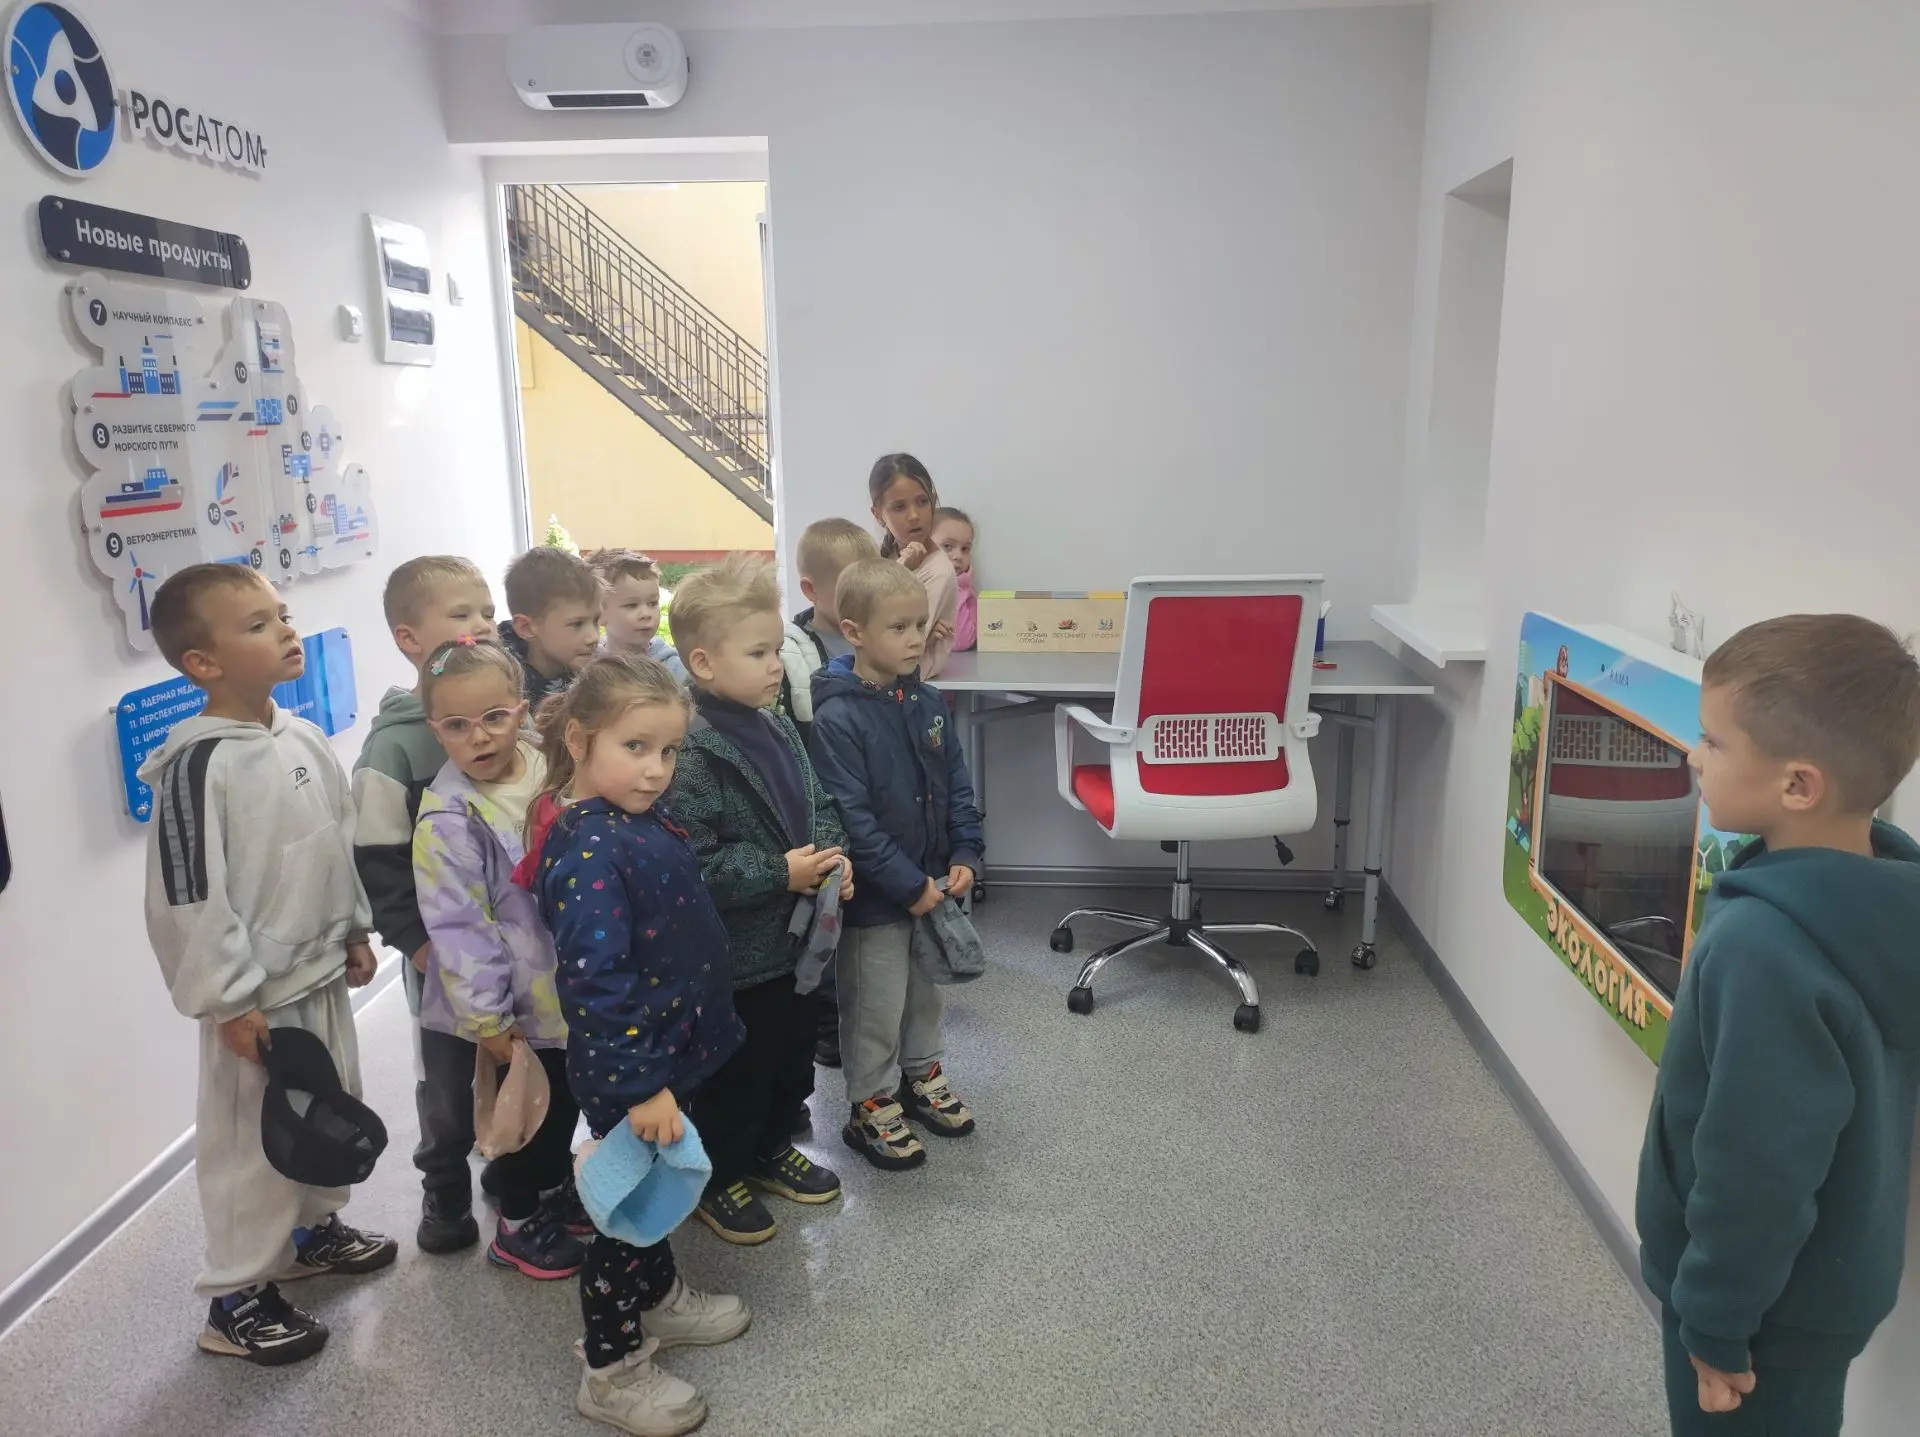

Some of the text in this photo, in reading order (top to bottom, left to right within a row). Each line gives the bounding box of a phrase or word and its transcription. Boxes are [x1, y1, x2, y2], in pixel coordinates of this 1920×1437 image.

[131, 91, 266, 168] РОСАТОМ
[75, 218, 232, 271] Новые продукты
[93, 304, 102, 321] 7
[112, 310, 193, 327] НАУЧНЫЙ КОМПЛЕКС
[235, 366, 246, 379] 10
[288, 398, 296, 412] 11
[97, 427, 106, 444] 8
[112, 423, 196, 434] РАЗВИТИЕ СЕВЕРНОГО
[114, 440, 179, 452] МОРСКОГО ПУТИ
[302, 435, 311, 446] 12
[307, 497, 316, 509] 13
[209, 508, 220, 520] 16
[126, 527, 197, 546] ВЕТРОЭНЕРГЕТИКА
[110, 538, 119, 554] 9
[251, 553, 261, 565] 15
[281, 553, 290, 565] 14
[141, 690, 176, 709] ЯДЕРНАЯ
[129, 719, 139, 729] 11.
[140, 696, 202, 726] ПЕРСПЕКТИВНЫЕ
[132, 736, 142, 747] 12.
[1547, 898, 1647, 1029] ЭКОЛОГИЯ
